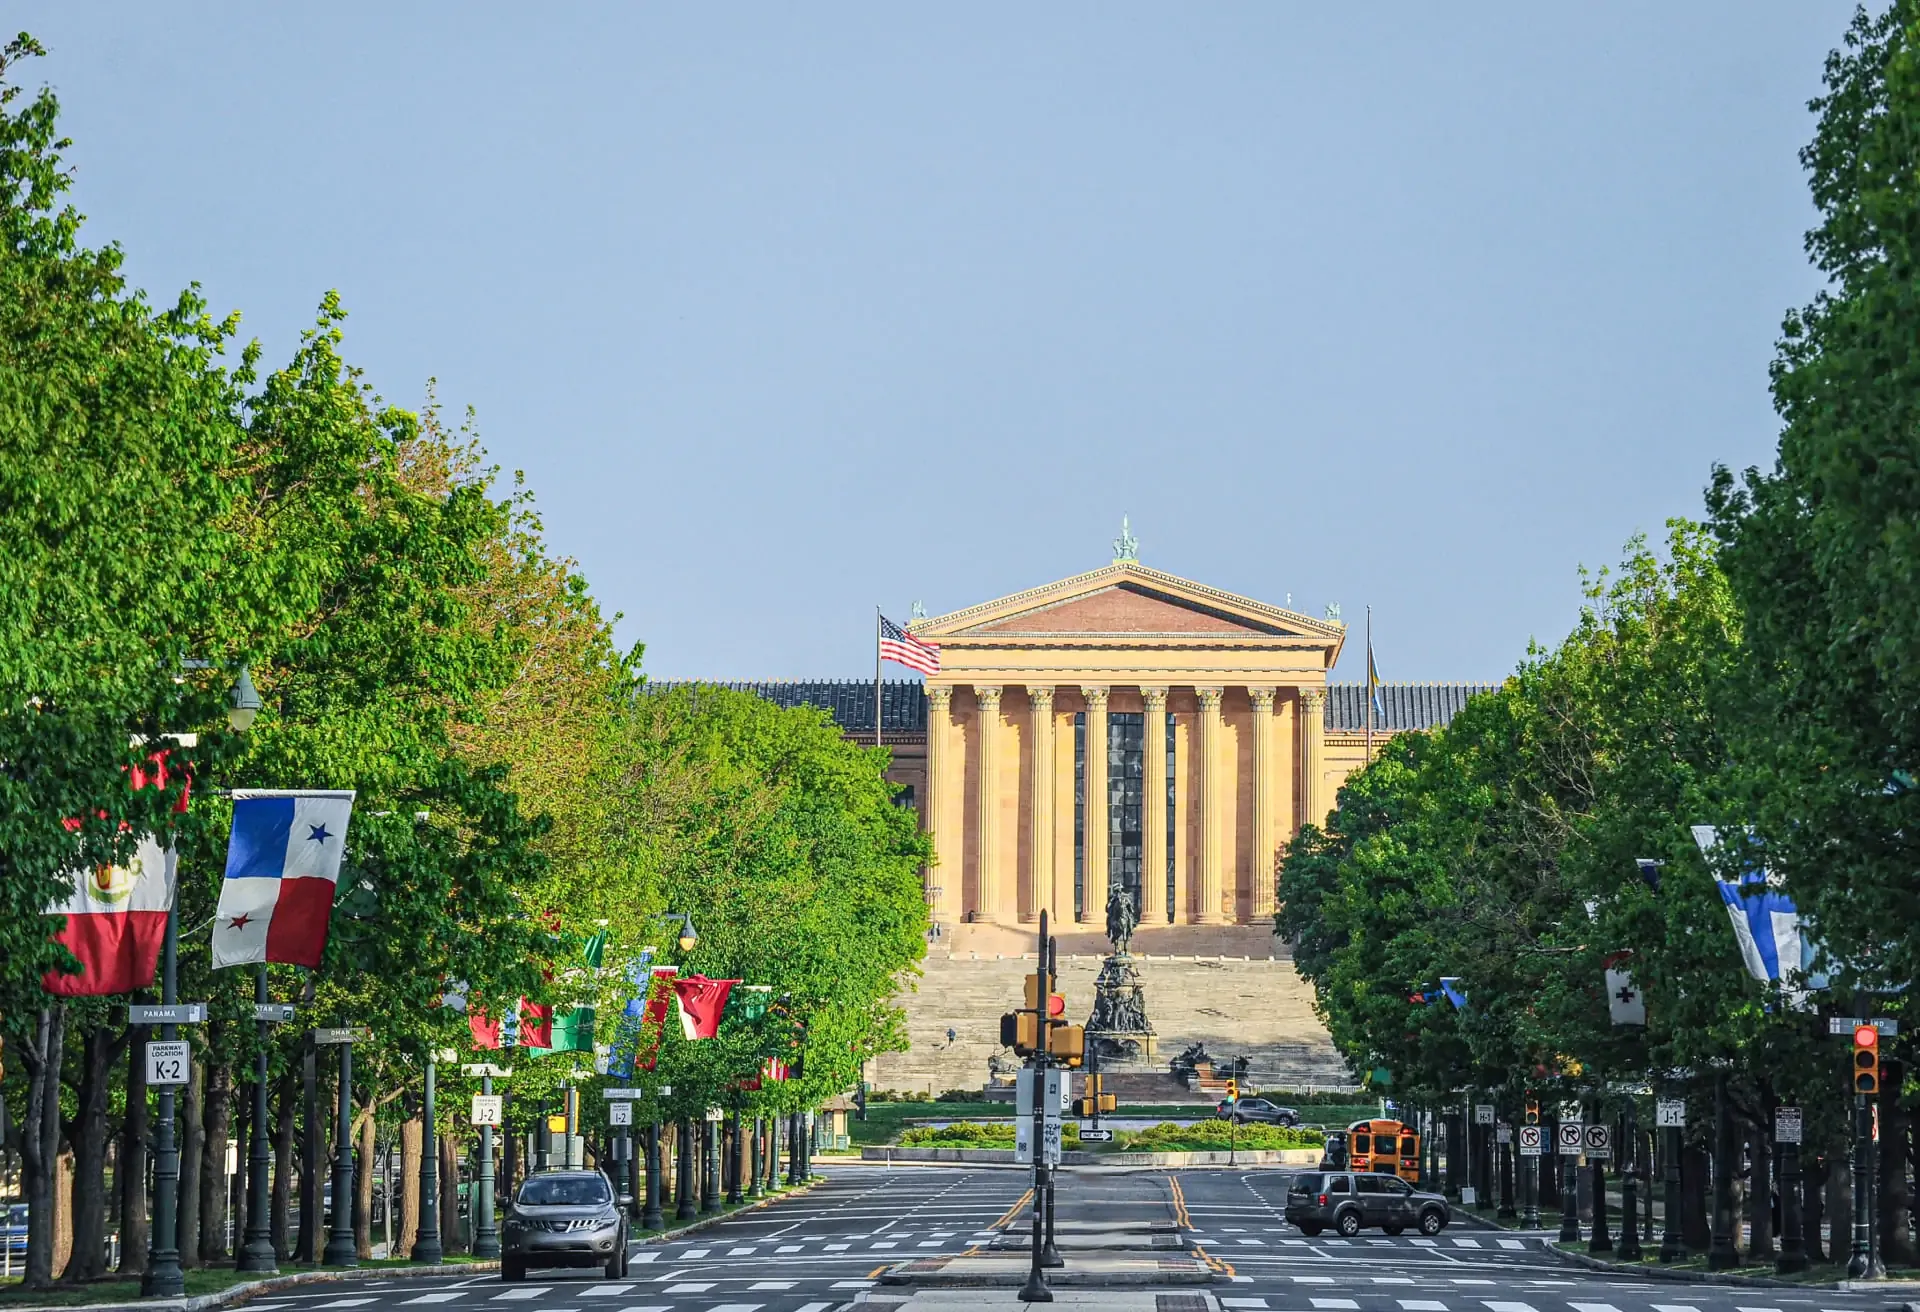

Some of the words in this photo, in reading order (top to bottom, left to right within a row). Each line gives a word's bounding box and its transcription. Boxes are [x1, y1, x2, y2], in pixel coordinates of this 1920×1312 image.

[1852, 1019, 1884, 1027] FIAND
[156, 1060, 180, 1079] K-2
[1063, 1094, 1068, 1103] S
[479, 1108, 493, 1121] J-2
[1664, 1110, 1677, 1123] J-1
